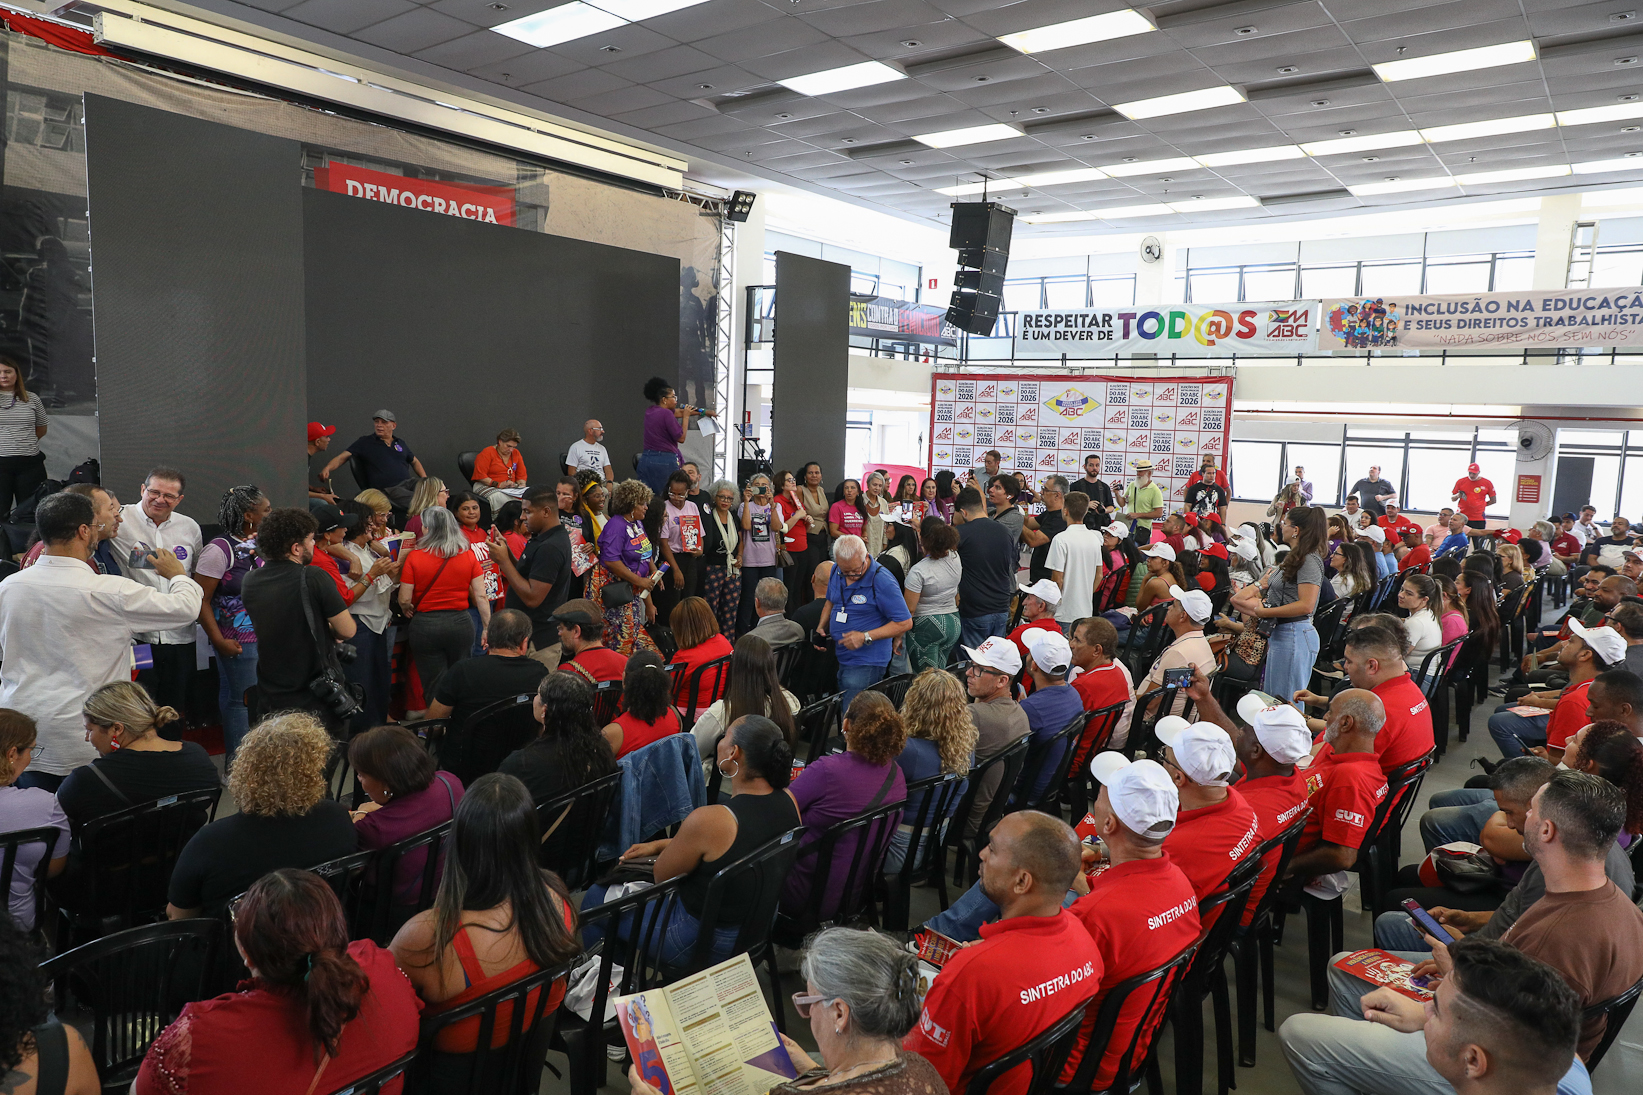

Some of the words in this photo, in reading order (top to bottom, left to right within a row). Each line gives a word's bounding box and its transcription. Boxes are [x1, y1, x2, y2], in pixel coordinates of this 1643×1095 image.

[346, 180, 498, 224] DEMOCRACIA
[1405, 298, 1500, 316] INCLUSÃO
[1506, 300, 1535, 312] NA
[1023, 313, 1113, 328] RESPEITAR
[1117, 310, 1258, 346] TOD@S
[1267, 324, 1308, 338] ABC
[1404, 320, 1412, 330] E
[1416, 319, 1452, 330] SEUS
[1457, 317, 1529, 329] DIREITOS
[1022, 328, 1029, 340] É
[1032, 331, 1050, 340] UM
[1054, 330, 1094, 340] DEVER
[1097, 330, 1113, 340] DE
[1478, 333, 1522, 342] SOBRE
[1564, 330, 1592, 341] SEM
[1059, 408, 1083, 416] ABC
[1277, 805, 1300, 824] SINTETRA
[1229, 828, 1255, 860] SINTETRA
[1148, 904, 1184, 930] SINTETRA
[1184, 899, 1192, 912] DO
[1020, 974, 1070, 1004] SINTETRA
[1071, 968, 1083, 984] DO
